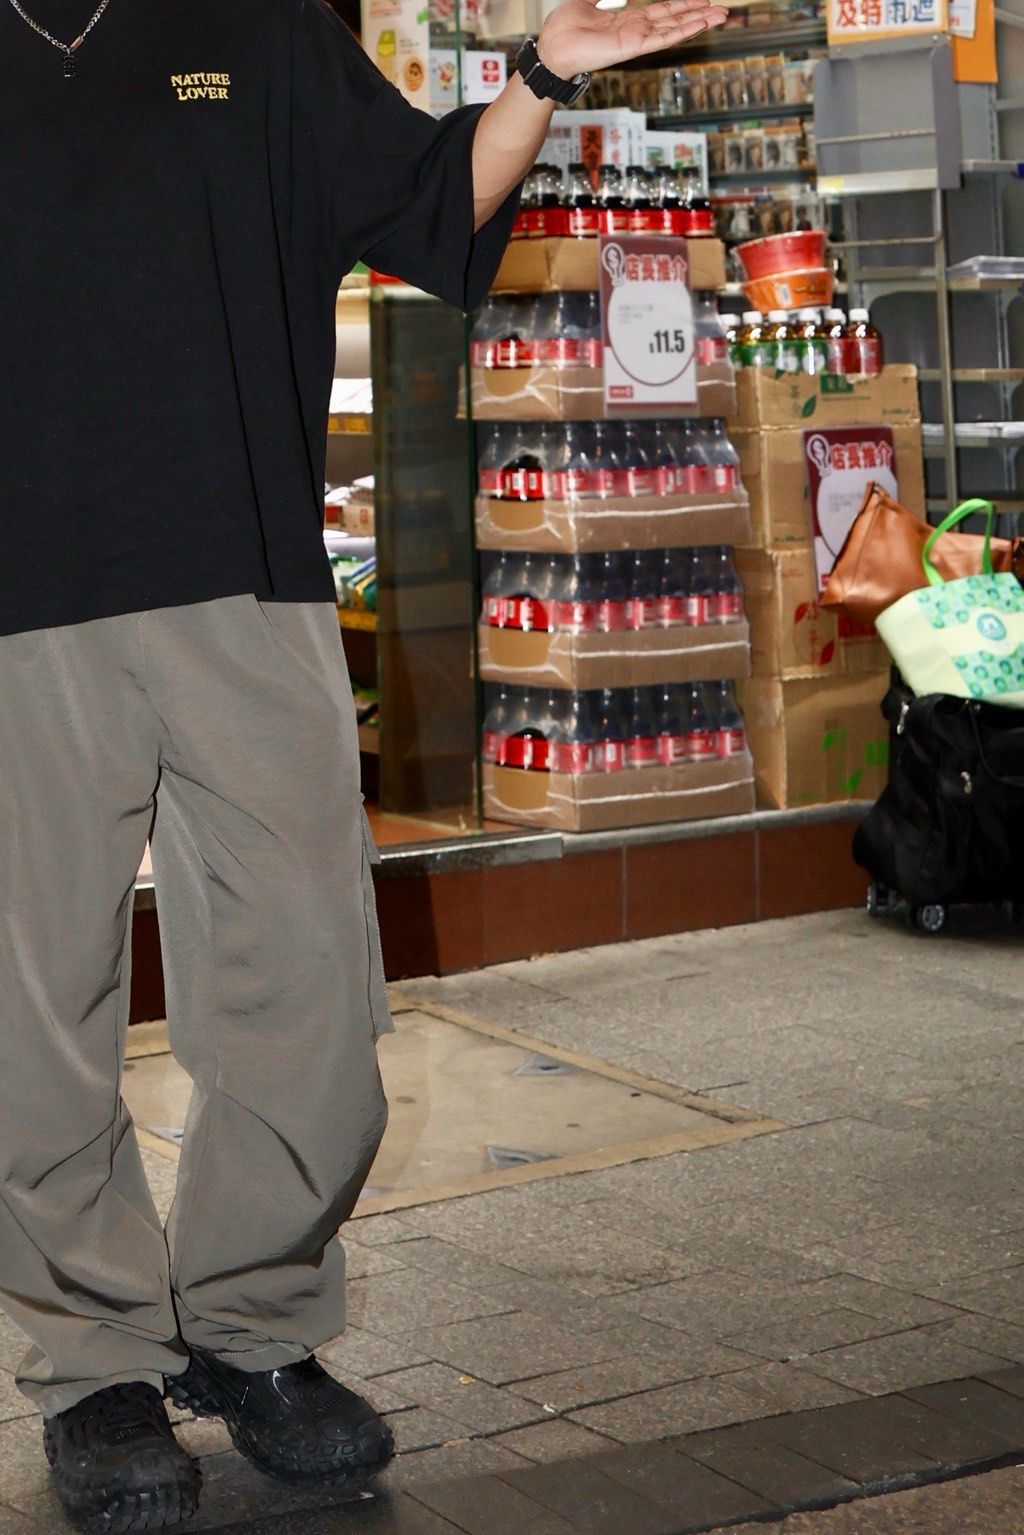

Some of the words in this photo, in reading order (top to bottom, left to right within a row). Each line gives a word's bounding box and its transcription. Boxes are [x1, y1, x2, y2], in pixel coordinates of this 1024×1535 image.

[171, 72, 231, 87] NATURE
[176, 86, 229, 101] LOVER
[649, 329, 685, 354] $11.5
